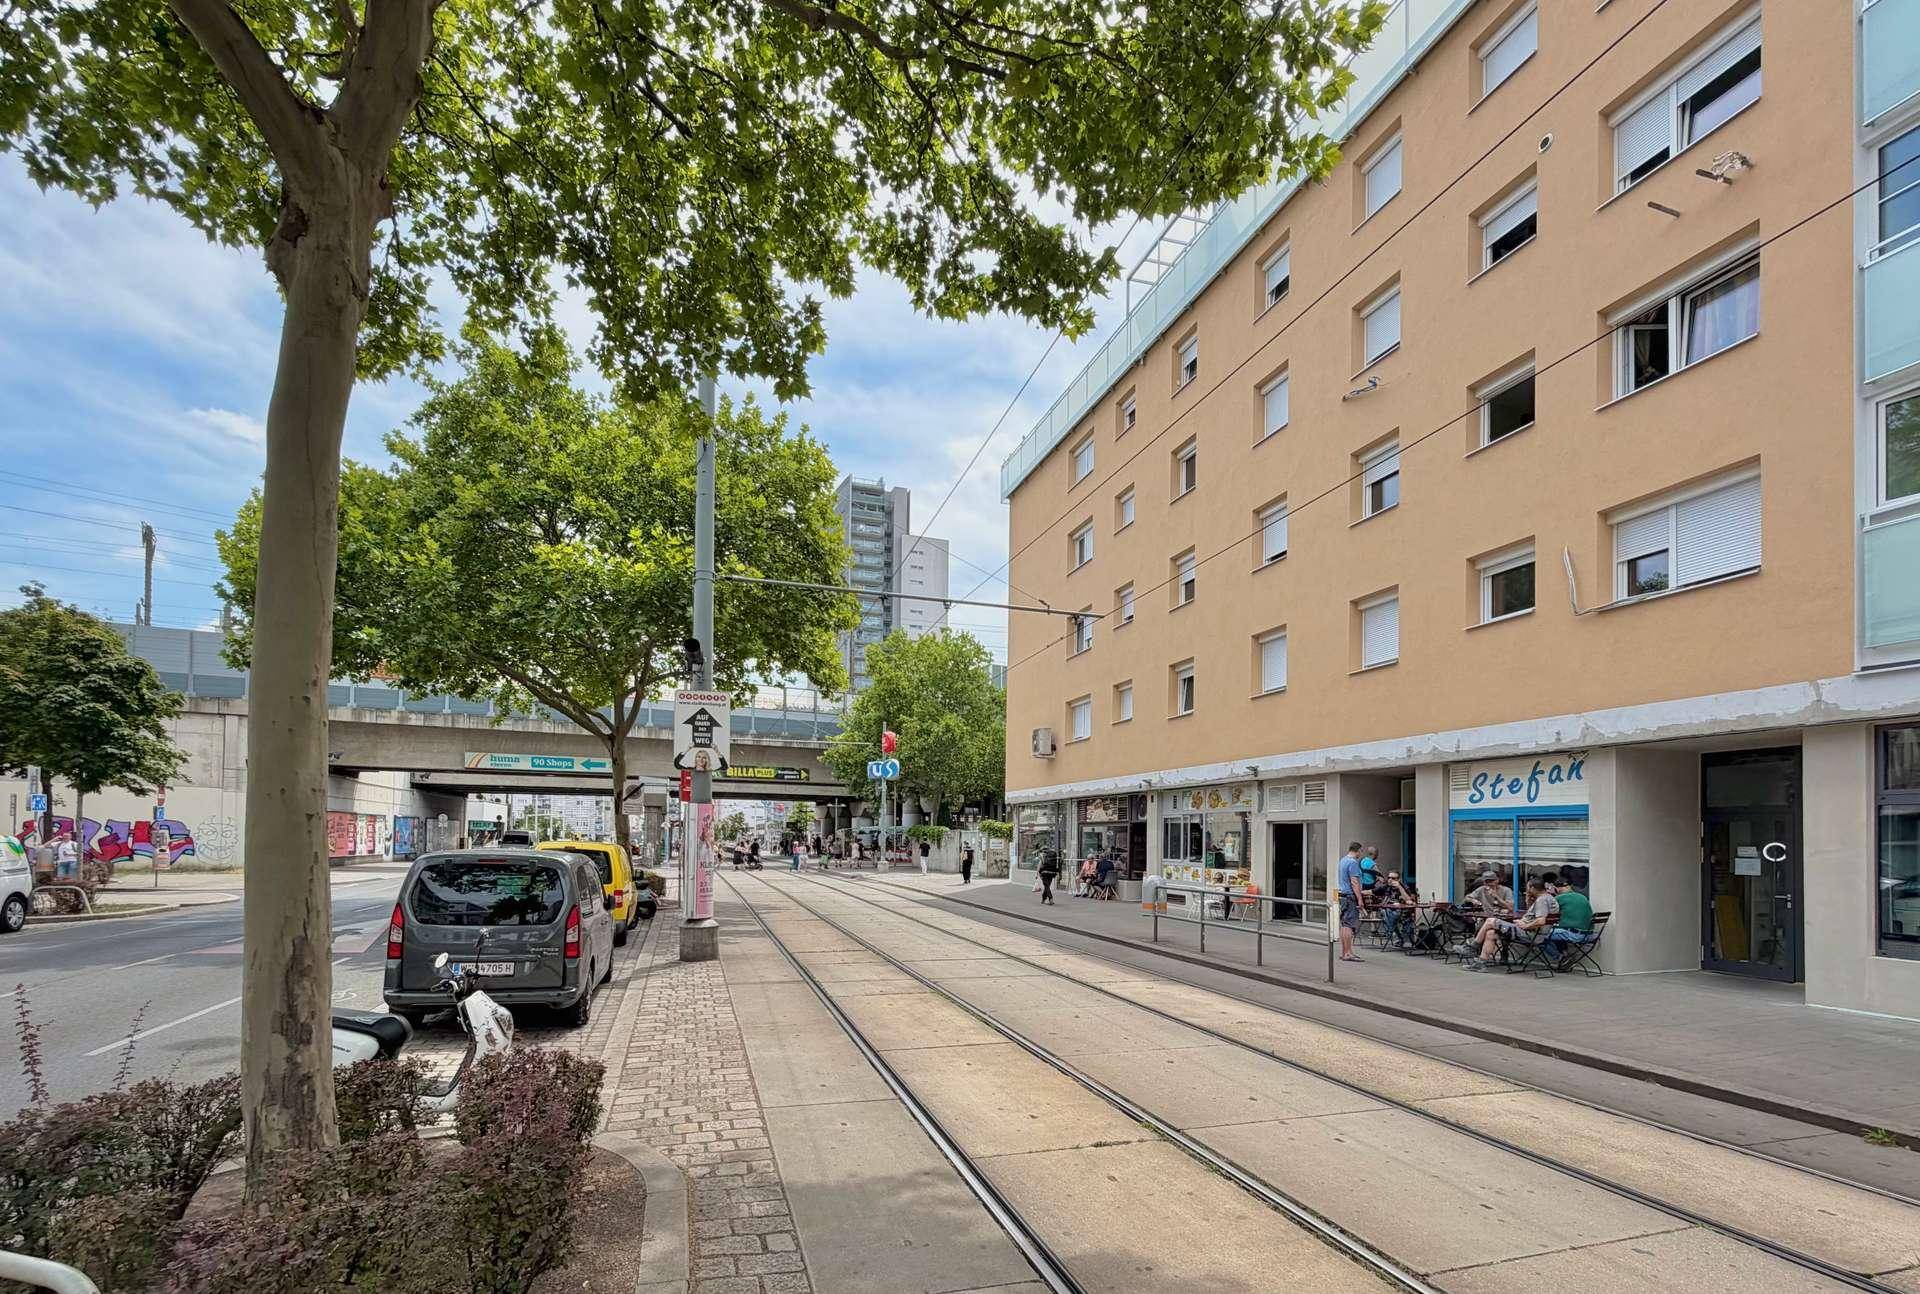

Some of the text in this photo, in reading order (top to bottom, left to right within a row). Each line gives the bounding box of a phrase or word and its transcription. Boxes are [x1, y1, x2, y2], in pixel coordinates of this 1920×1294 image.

[490, 754, 520, 763] huma
[533, 758, 573, 768] 90 Shops
[726, 767, 755, 778] BILLA
[872, 764, 882, 777] U
[1468, 758, 1585, 804] Stefan
